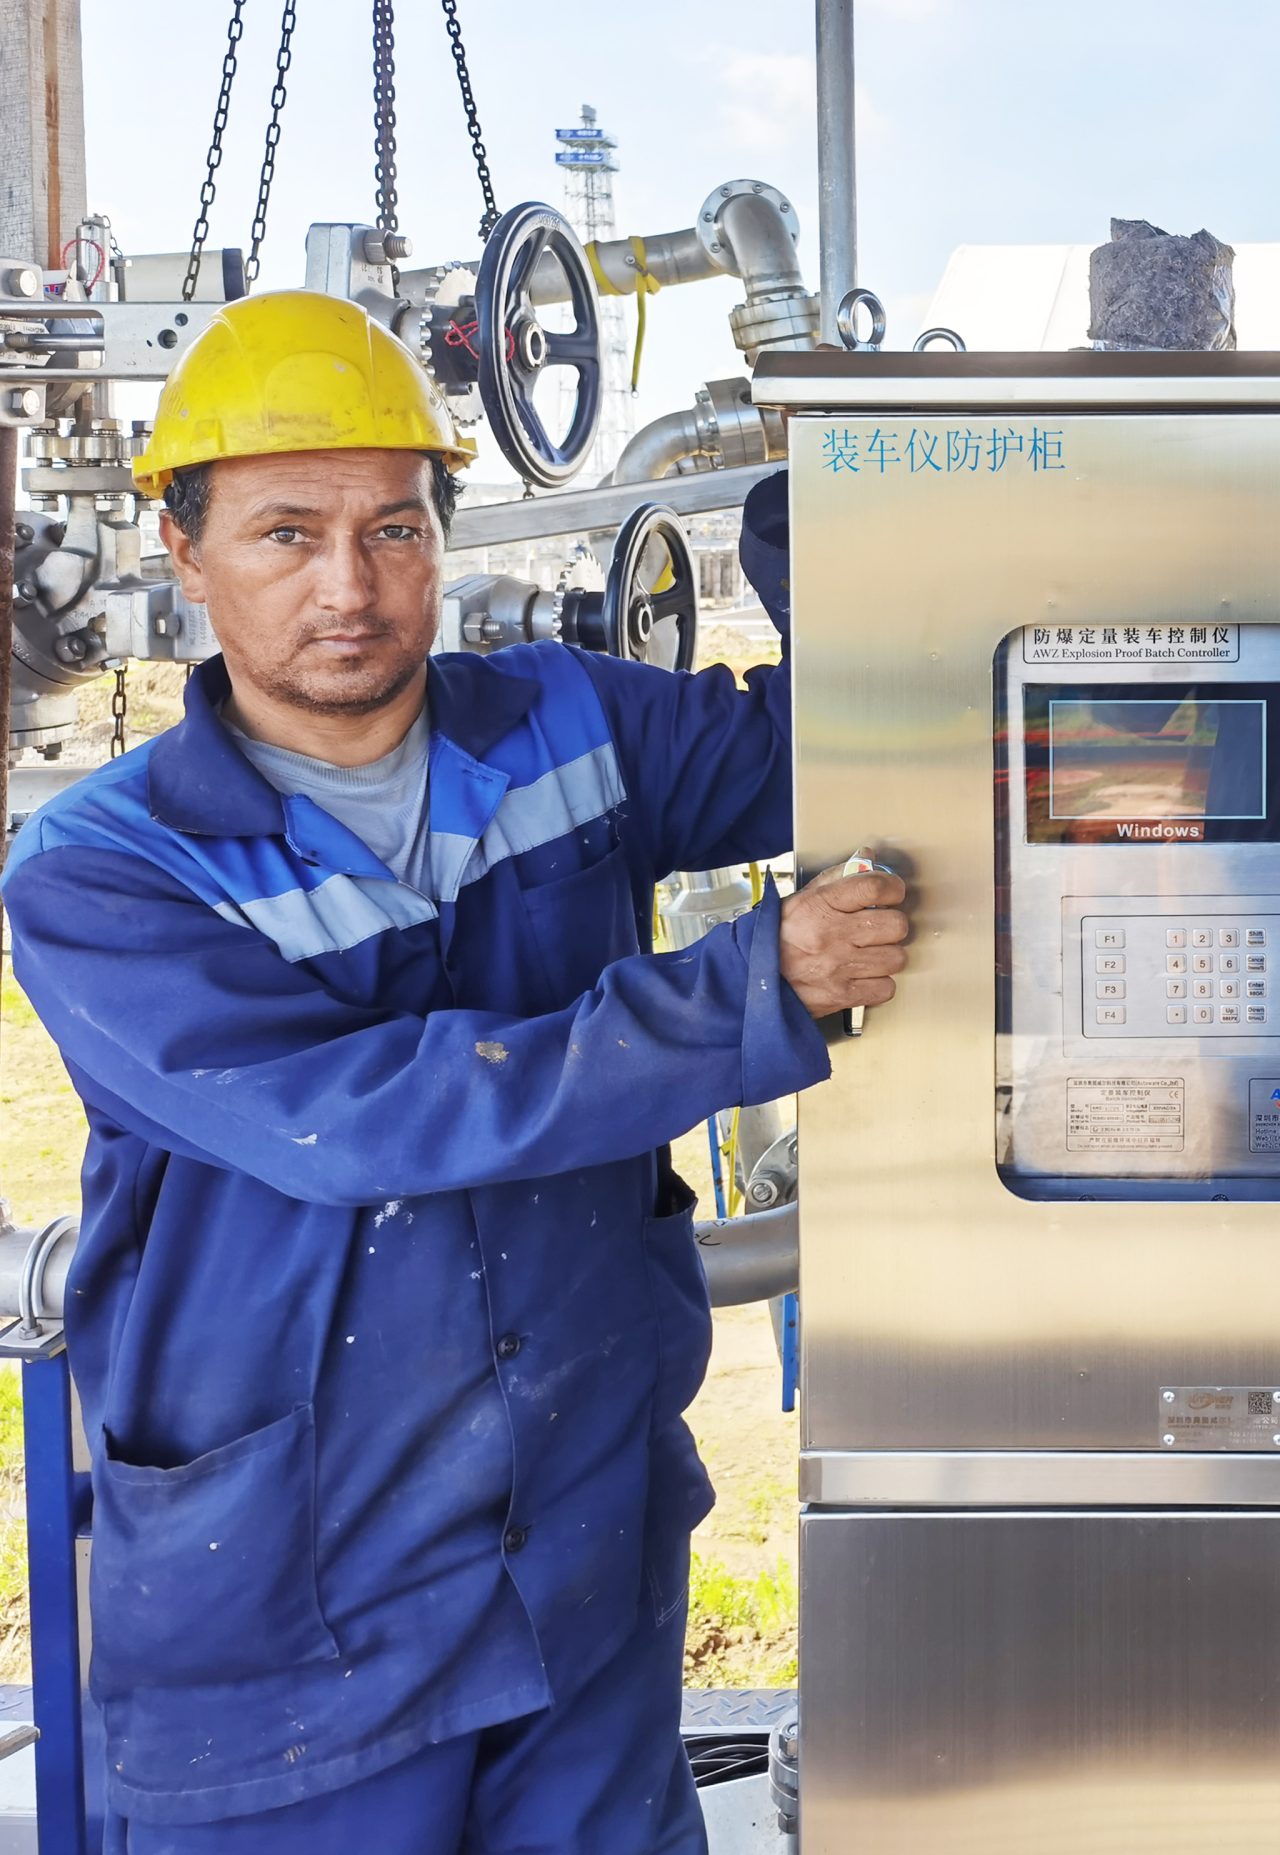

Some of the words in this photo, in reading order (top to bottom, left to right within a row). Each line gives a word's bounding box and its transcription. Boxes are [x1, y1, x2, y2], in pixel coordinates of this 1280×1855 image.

[821, 426, 1066, 473] 装车仪防护柜
[1033, 627, 1230, 645] 防爆定量装车控制仪
[1032, 649, 1060, 658] AWZ
[1062, 649, 1112, 660] Explosion
[1115, 648, 1142, 658] Proof
[1145, 648, 1175, 658] Batch
[1177, 648, 1231, 658] Controller
[1116, 823, 1200, 838] Windows
[1104, 935, 1116, 943] F1
[1173, 935, 1178, 943] 1
[1199, 935, 1206, 943] 2
[1225, 934, 1232, 943] 3
[1104, 961, 1116, 969] F2
[1173, 960, 1179, 968] 4
[1199, 960, 1206, 968] 5
[1226, 960, 1233, 968] 6
[1104, 986, 1117, 994] F3
[1173, 985, 1179, 993] 7
[1200, 985, 1206, 993] 8
[1226, 985, 1233, 993] 9
[1104, 1011, 1116, 1019] F4
[1200, 1010, 1207, 1018] 0
